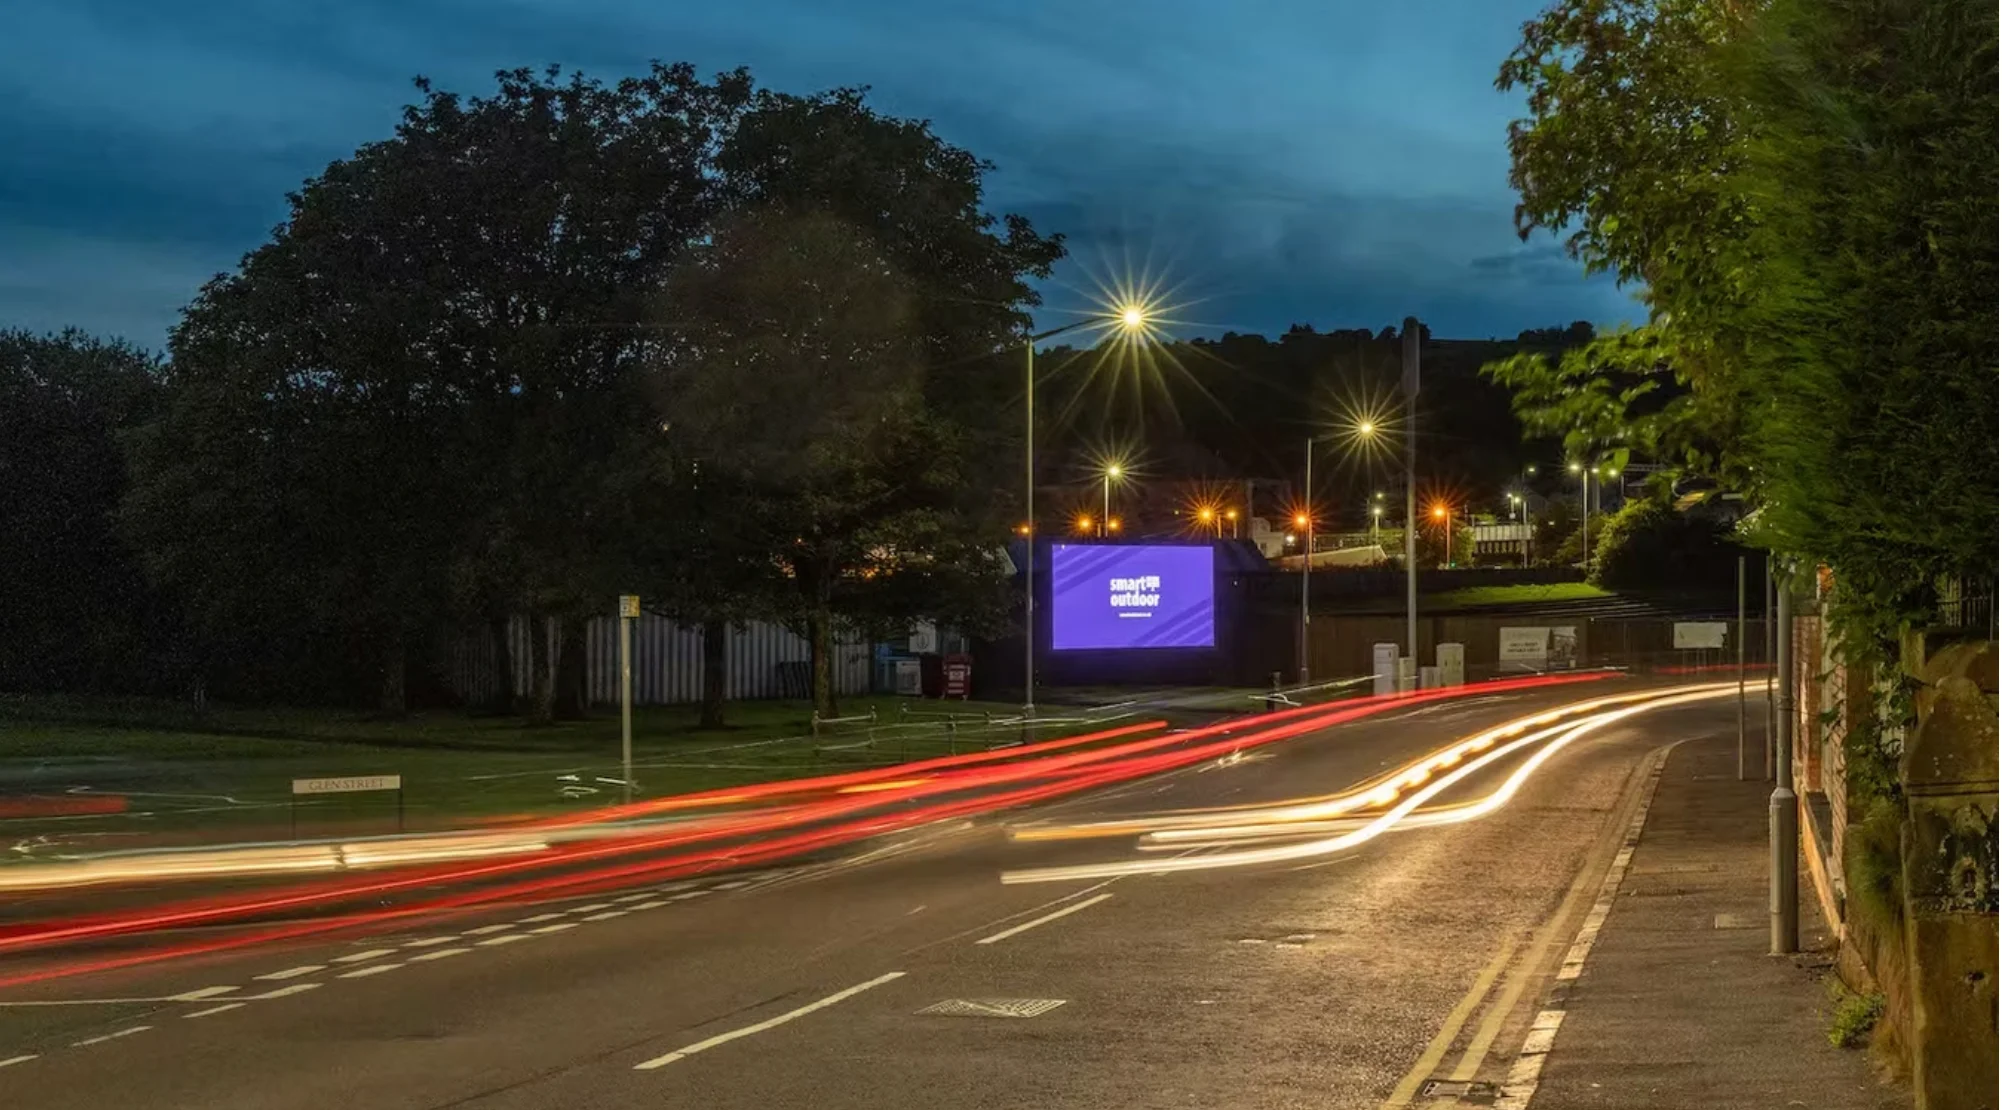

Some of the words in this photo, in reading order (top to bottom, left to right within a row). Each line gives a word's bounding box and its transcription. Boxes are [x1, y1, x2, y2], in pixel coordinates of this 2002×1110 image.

[1110, 576, 1146, 591] smart
[1110, 591, 1160, 607] outdoor
[308, 780, 340, 791] GLEN
[341, 778, 384, 789] STREET
